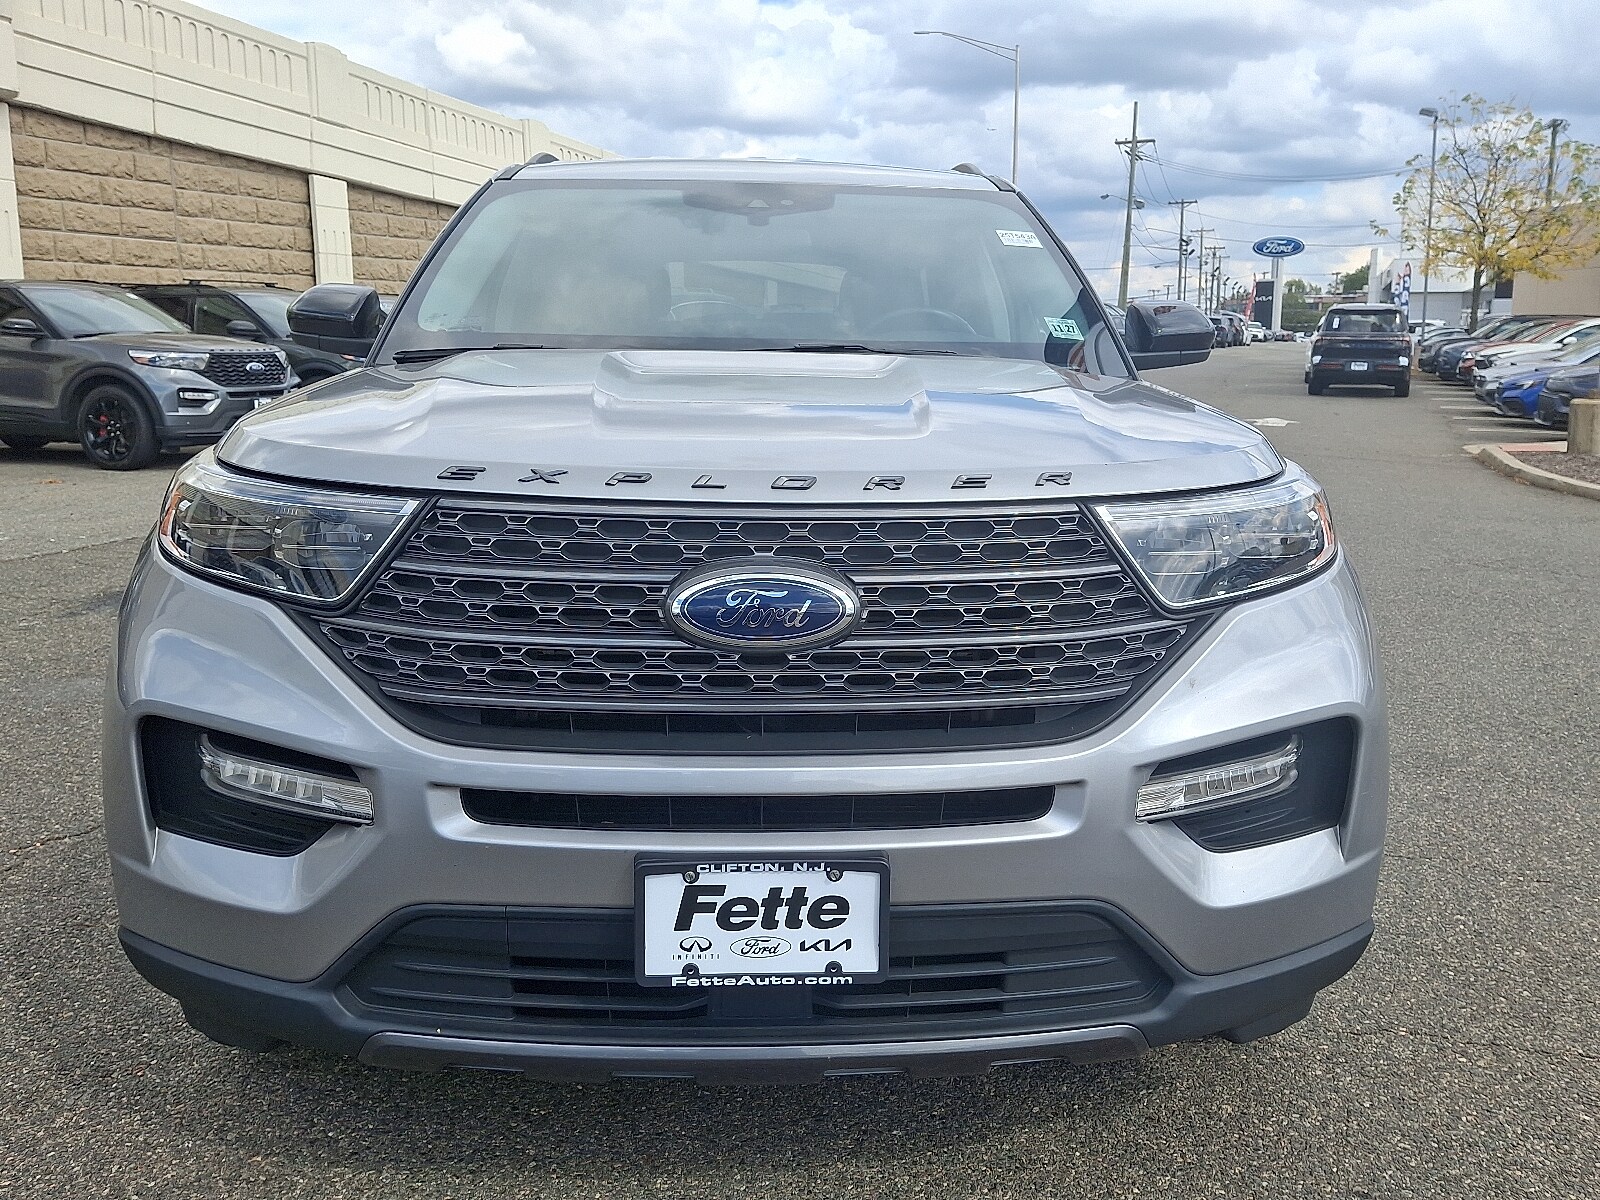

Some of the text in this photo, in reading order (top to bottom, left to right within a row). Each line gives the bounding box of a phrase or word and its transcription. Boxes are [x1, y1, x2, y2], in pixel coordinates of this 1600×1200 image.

[1263, 240, 1294, 253] Ford
[437, 465, 1073, 491] EXPLORER
[716, 588, 812, 628] Ford
[696, 862, 831, 873] CLIFTON, N.J.
[673, 884, 850, 932] Fette
[740, 938, 781, 956] Ford
[800, 938, 852, 952] KIA
[671, 975, 853, 987] FetteAuto.com
